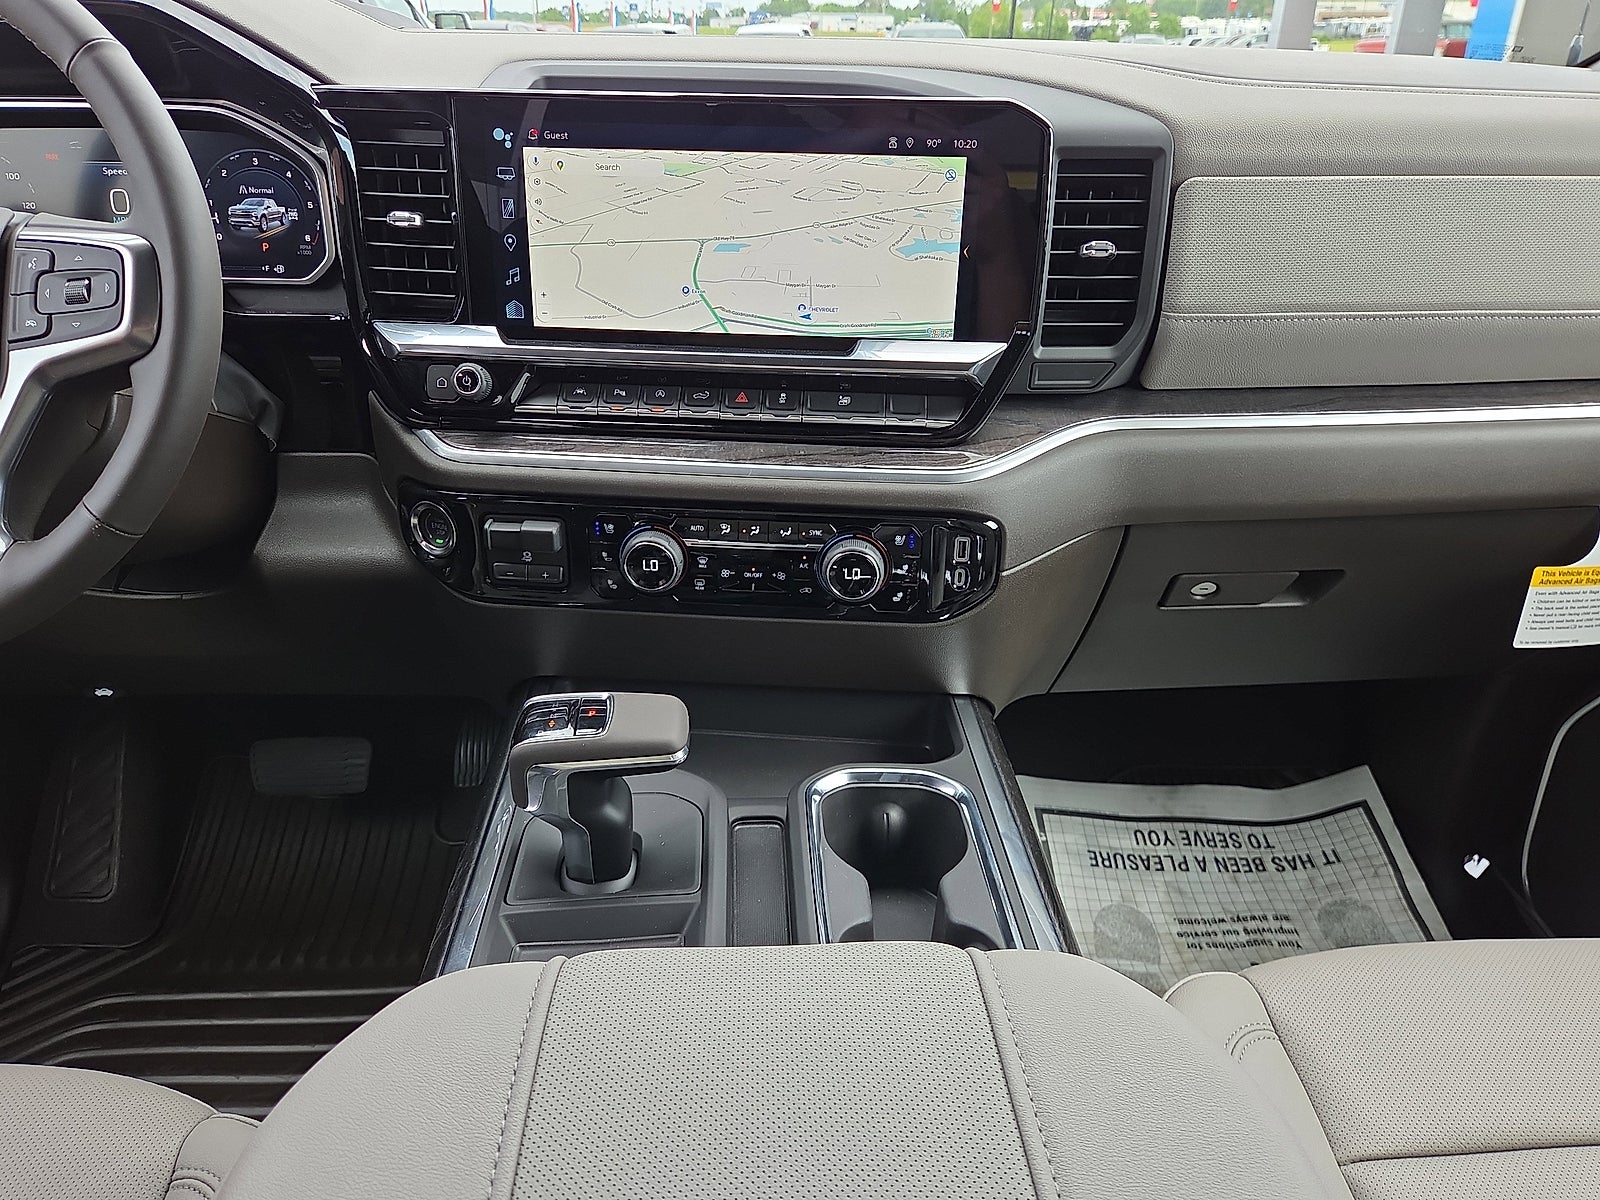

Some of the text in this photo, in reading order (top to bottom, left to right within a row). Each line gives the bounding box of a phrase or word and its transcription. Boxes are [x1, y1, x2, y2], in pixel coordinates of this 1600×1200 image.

[543, 131, 569, 140] Guest
[953, 139, 978, 149] 10:20
[595, 163, 621, 171] Search
[5, 172, 20, 181] 100
[248, 187, 275, 195] Normal
[22, 202, 36, 210] 120
[109, 188, 131, 215] 0
[262, 242, 270, 252] P
[808, 529, 823, 537] SYNC
[642, 559, 659, 571] LO
[743, 571, 763, 579] ON/OFF
[1558, 569, 1583, 577] Vehicle
[1538, 577, 1573, 585] Advanced
[1133, 829, 1276, 849] TO SERVE YOU
[1087, 847, 1341, 873] IT HAS BEEN A PLEASURE
[1229, 913, 1268, 923] always
[1277, 940, 1303, 950] Your
